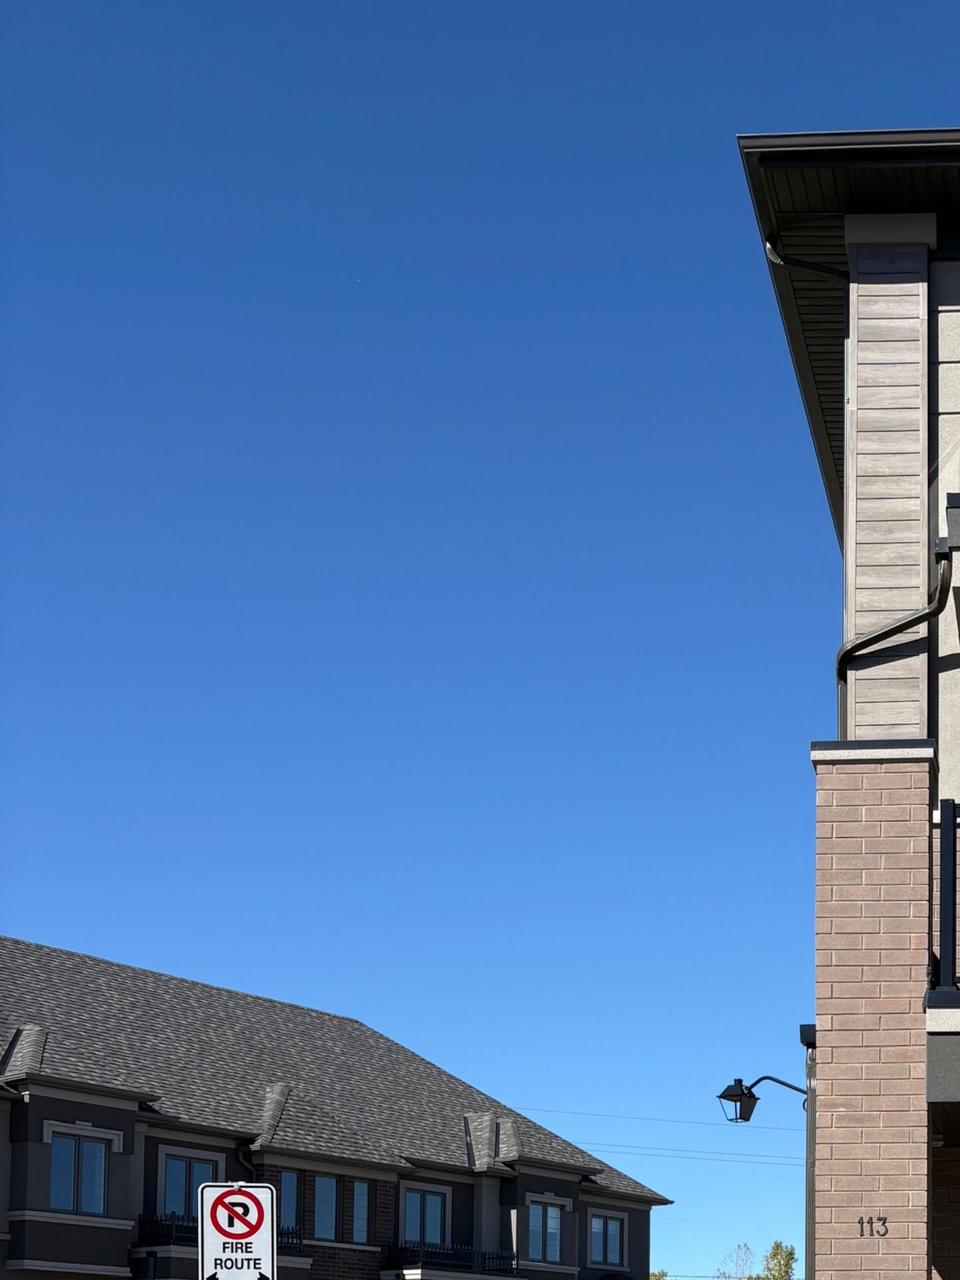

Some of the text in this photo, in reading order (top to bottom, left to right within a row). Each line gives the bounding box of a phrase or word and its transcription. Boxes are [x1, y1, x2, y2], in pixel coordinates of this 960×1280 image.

[857, 1216, 889, 1237] 113
[222, 1242, 253, 1253] FIRE
[214, 1258, 262, 1270] ROUTE
